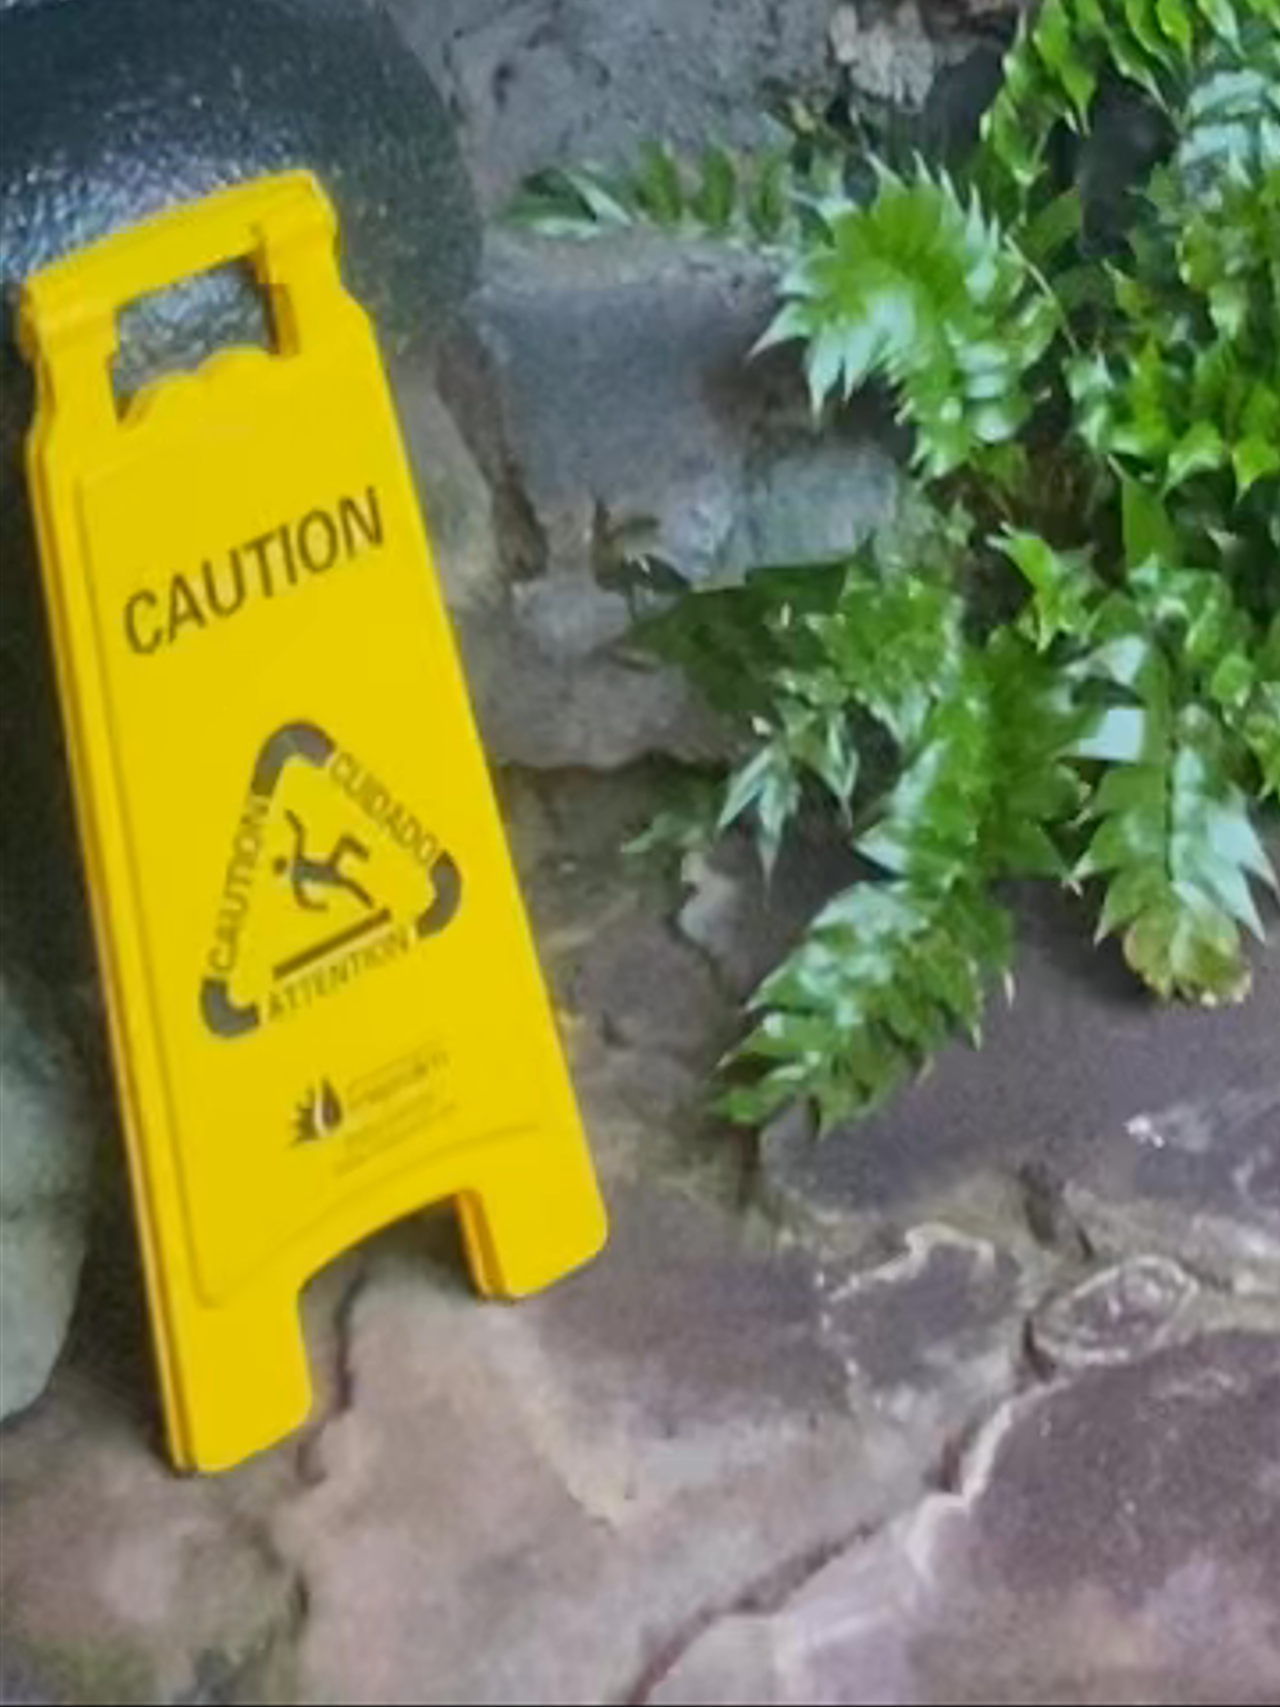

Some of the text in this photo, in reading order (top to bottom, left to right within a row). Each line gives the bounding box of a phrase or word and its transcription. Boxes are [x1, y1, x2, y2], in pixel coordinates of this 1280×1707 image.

[122, 484, 384, 656] CAUTION
[330, 751, 439, 867] CUIDADO
[206, 801, 270, 974] CAUTION
[268, 923, 409, 1022] ATTENTION
